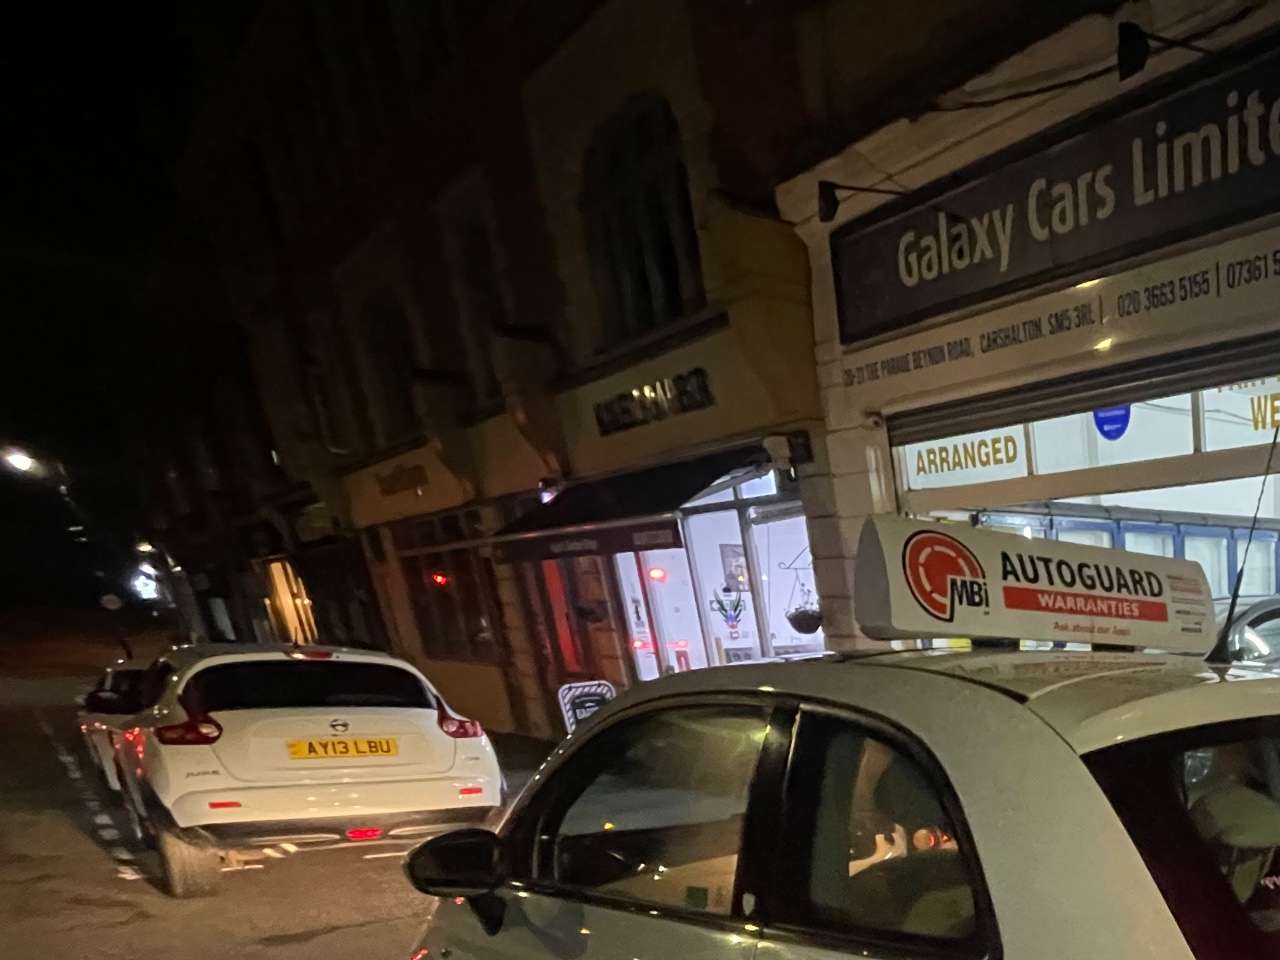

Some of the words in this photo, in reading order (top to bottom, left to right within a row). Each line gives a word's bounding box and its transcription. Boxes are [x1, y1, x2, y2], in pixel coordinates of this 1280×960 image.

[898, 203, 1014, 287] Galaxy
[1028, 164, 1116, 241] Cars
[1117, 289, 1140, 317] 020
[1226, 256, 1270, 289] 07361
[916, 435, 1018, 476] ARRANGED
[1001, 551, 1164, 597] AUTOGUARD
[1038, 591, 1140, 618] WARRANTIES
[307, 740, 348, 756] AY13
[352, 739, 391, 755] LBU
